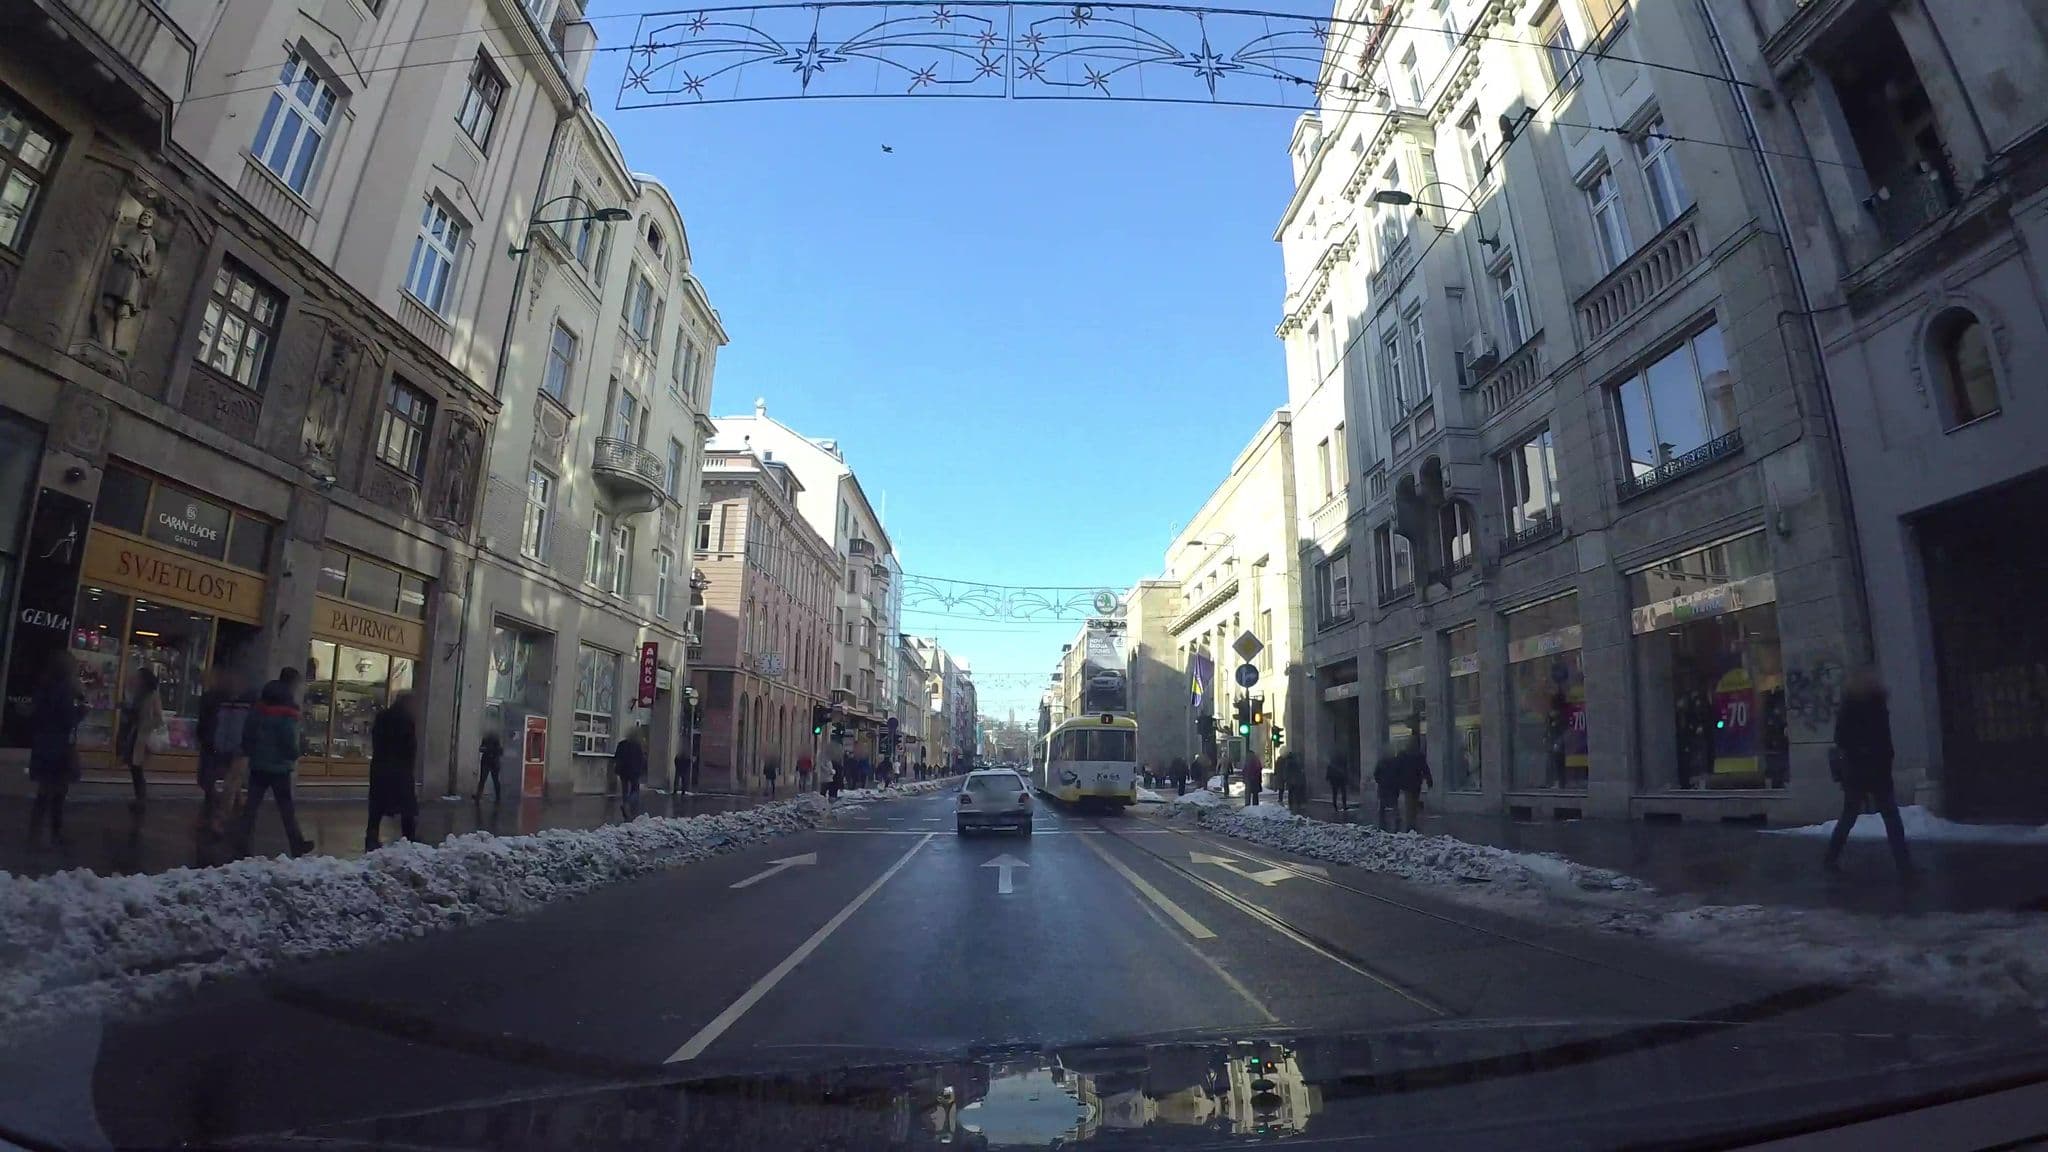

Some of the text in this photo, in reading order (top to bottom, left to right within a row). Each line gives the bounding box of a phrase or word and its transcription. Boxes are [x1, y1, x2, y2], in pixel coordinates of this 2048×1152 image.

[159, 512, 189, 531] CARAN
[118, 551, 238, 602] SVJETLOST
[330, 608, 405, 645] PAPIRNICA
[644, 647, 654, 684] AMKO
[1727, 702, 1747, 727] 70
